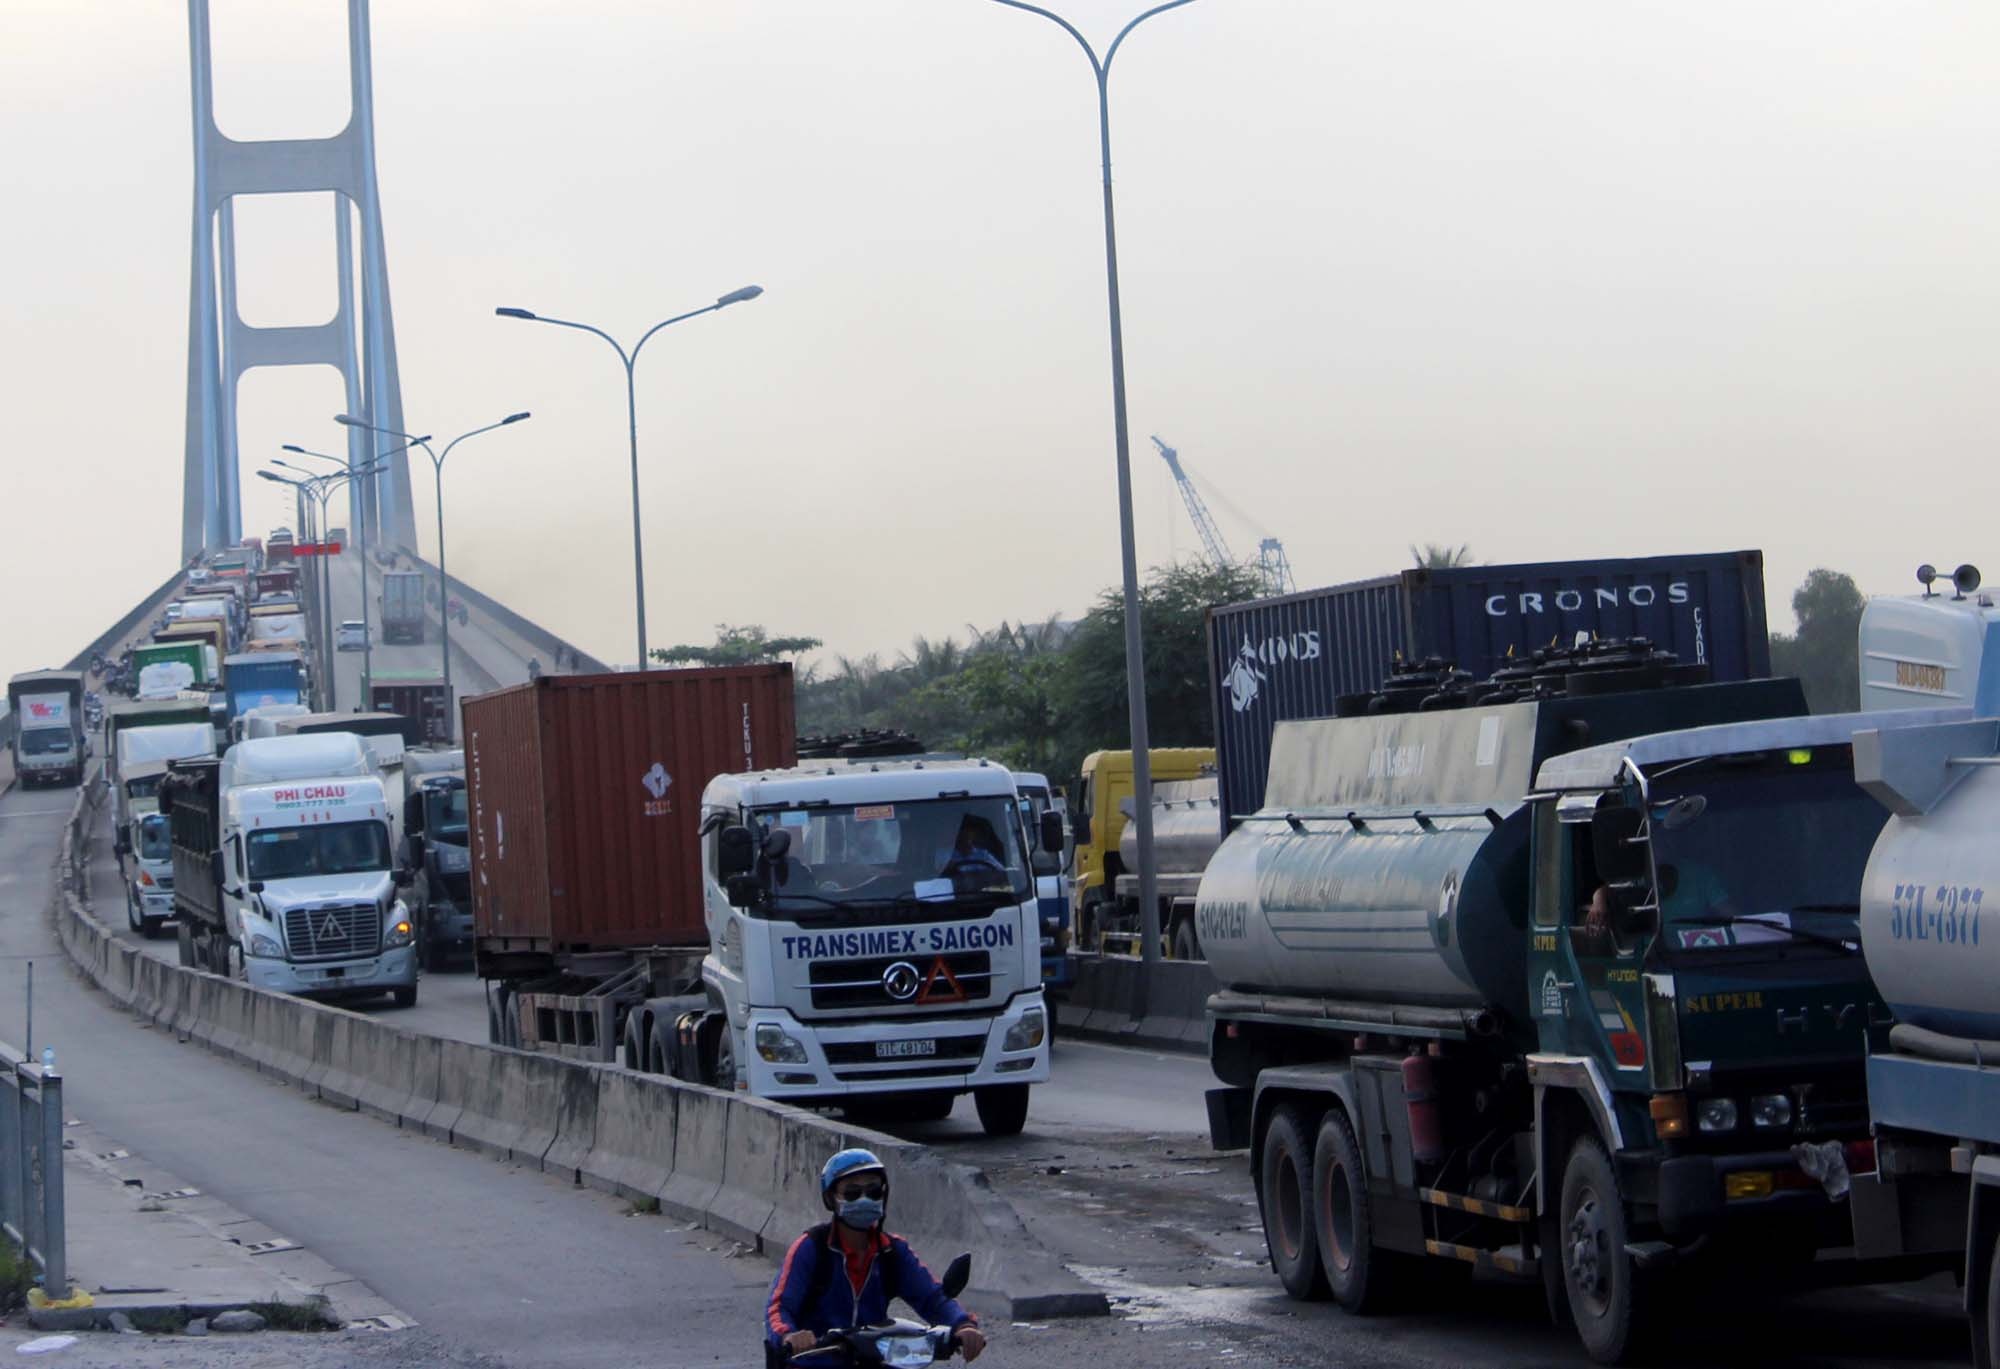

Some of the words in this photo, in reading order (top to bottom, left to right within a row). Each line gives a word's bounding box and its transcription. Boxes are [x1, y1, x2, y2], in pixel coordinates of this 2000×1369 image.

[1485, 582, 1689, 616] CRONOS
[274, 789, 299, 802] PHI
[1892, 884, 1984, 945] 57L-7377
[782, 930, 915, 959] TRANSIMEX
[930, 923, 1013, 950] SAIGON
[1686, 991, 1764, 1013] SUPER
